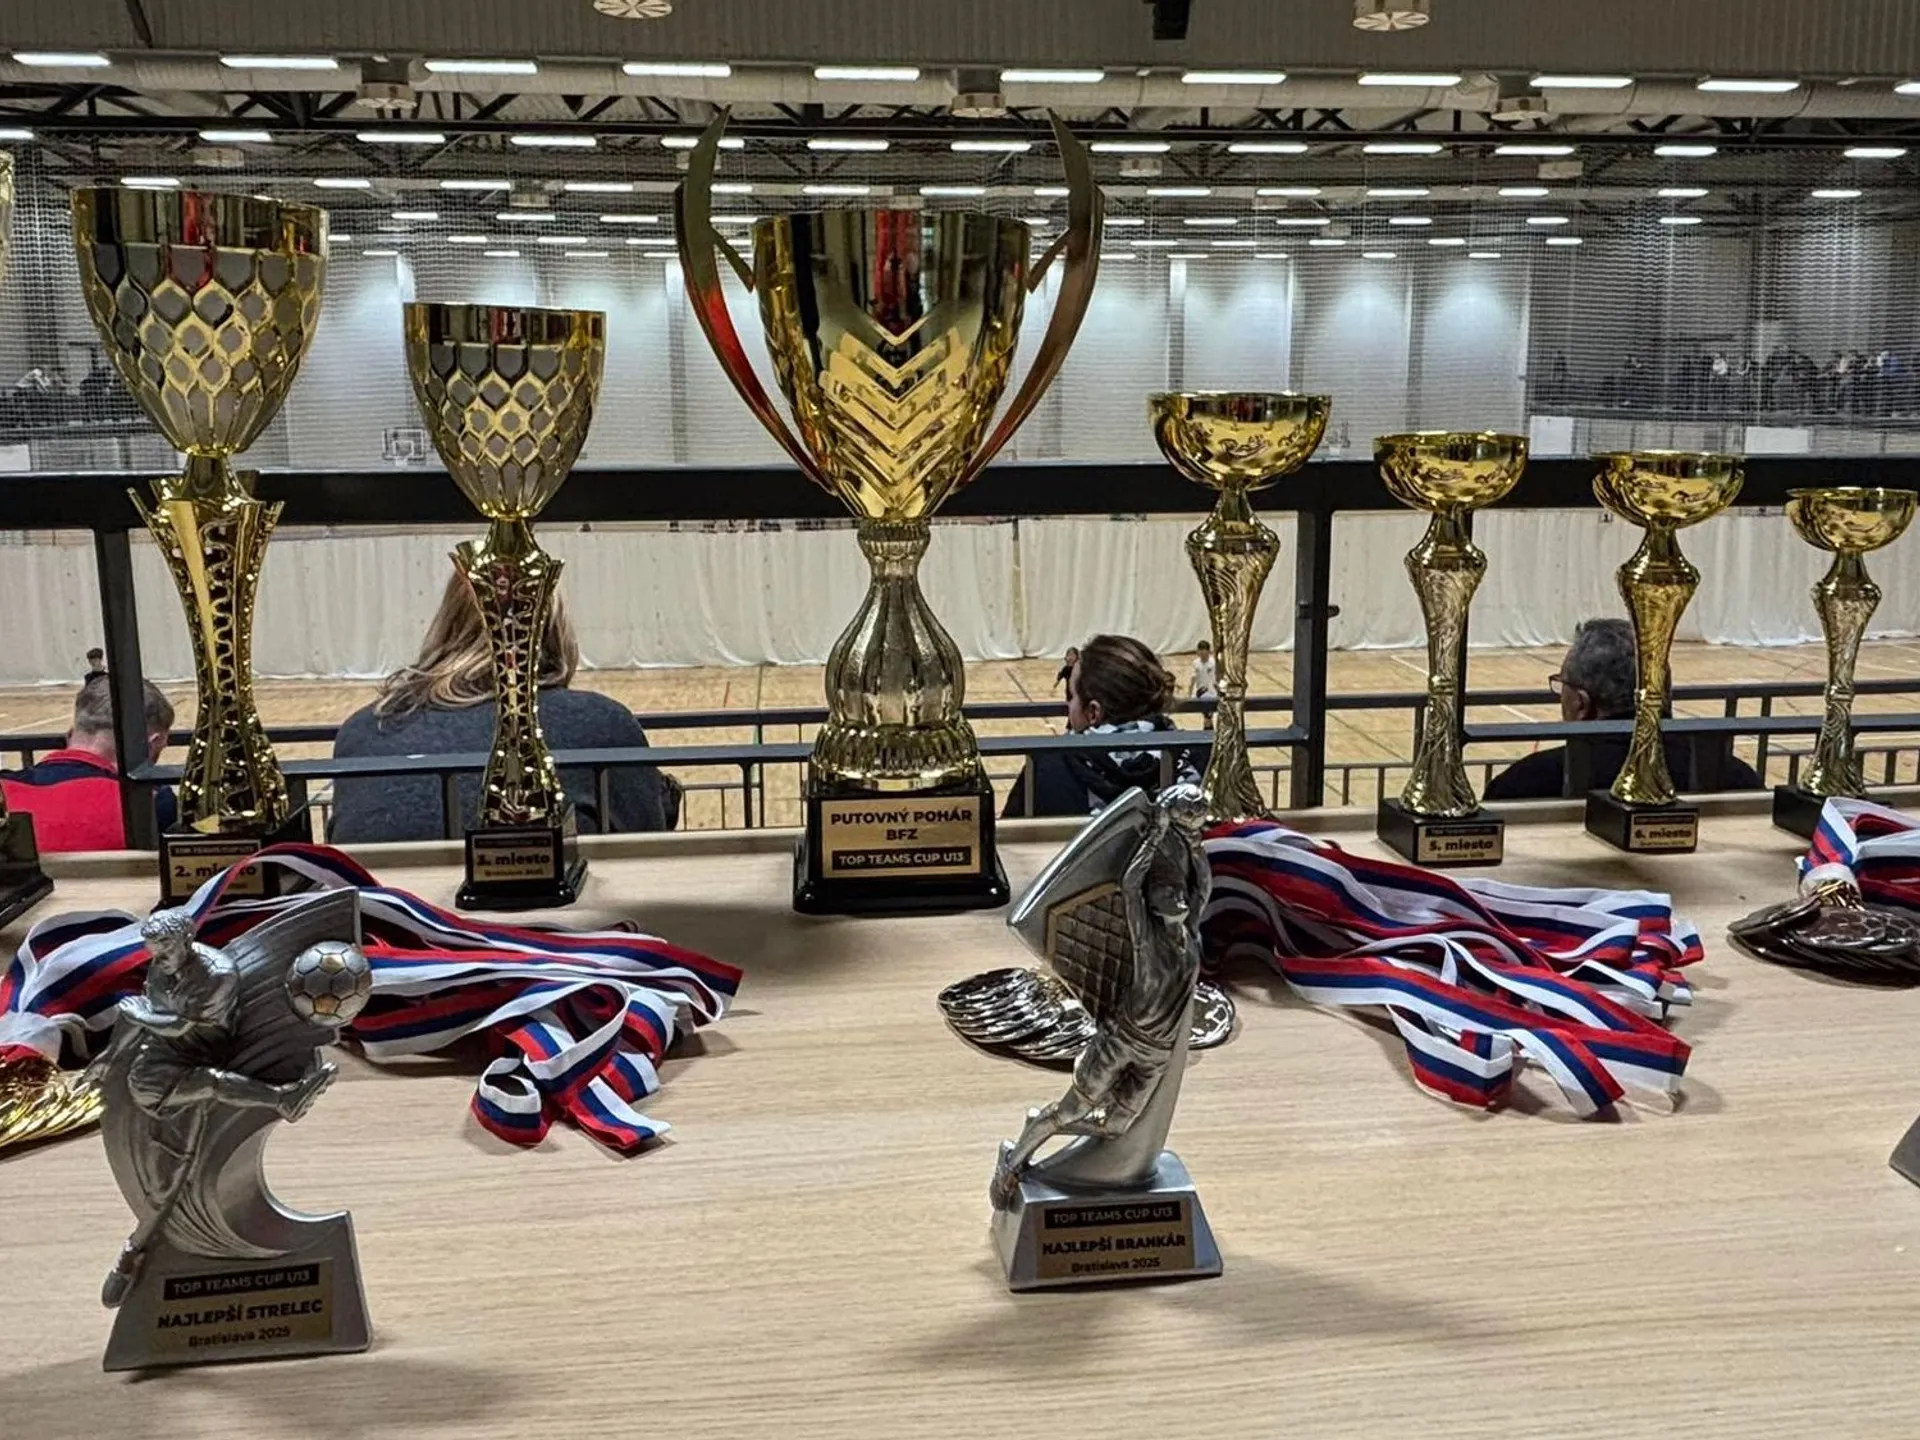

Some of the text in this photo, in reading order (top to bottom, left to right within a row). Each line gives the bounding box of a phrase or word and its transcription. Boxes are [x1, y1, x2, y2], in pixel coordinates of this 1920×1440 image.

[831, 807, 972, 825] PUTOVNÝ POHÁR
[886, 828, 918, 841] BFZ
[1429, 838, 1494, 851] 5. miesto
[495, 851, 551, 866] miesto
[839, 851, 964, 866] TOP TEAMS CUP U13
[174, 865, 192, 877] 2.
[1053, 1206, 1174, 1224] TOP TEAMS CUP U13
[1042, 1231, 1186, 1256] NAJLEPŠÍ BRANKÁR
[1071, 1256, 1161, 1274] Bratislava 2025
[173, 1269, 311, 1295] TOP TEAMS CUP U13
[157, 1299, 323, 1329] NAJLEPŠÍ STRELEC
[188, 1325, 291, 1348] Bratislava 2025
